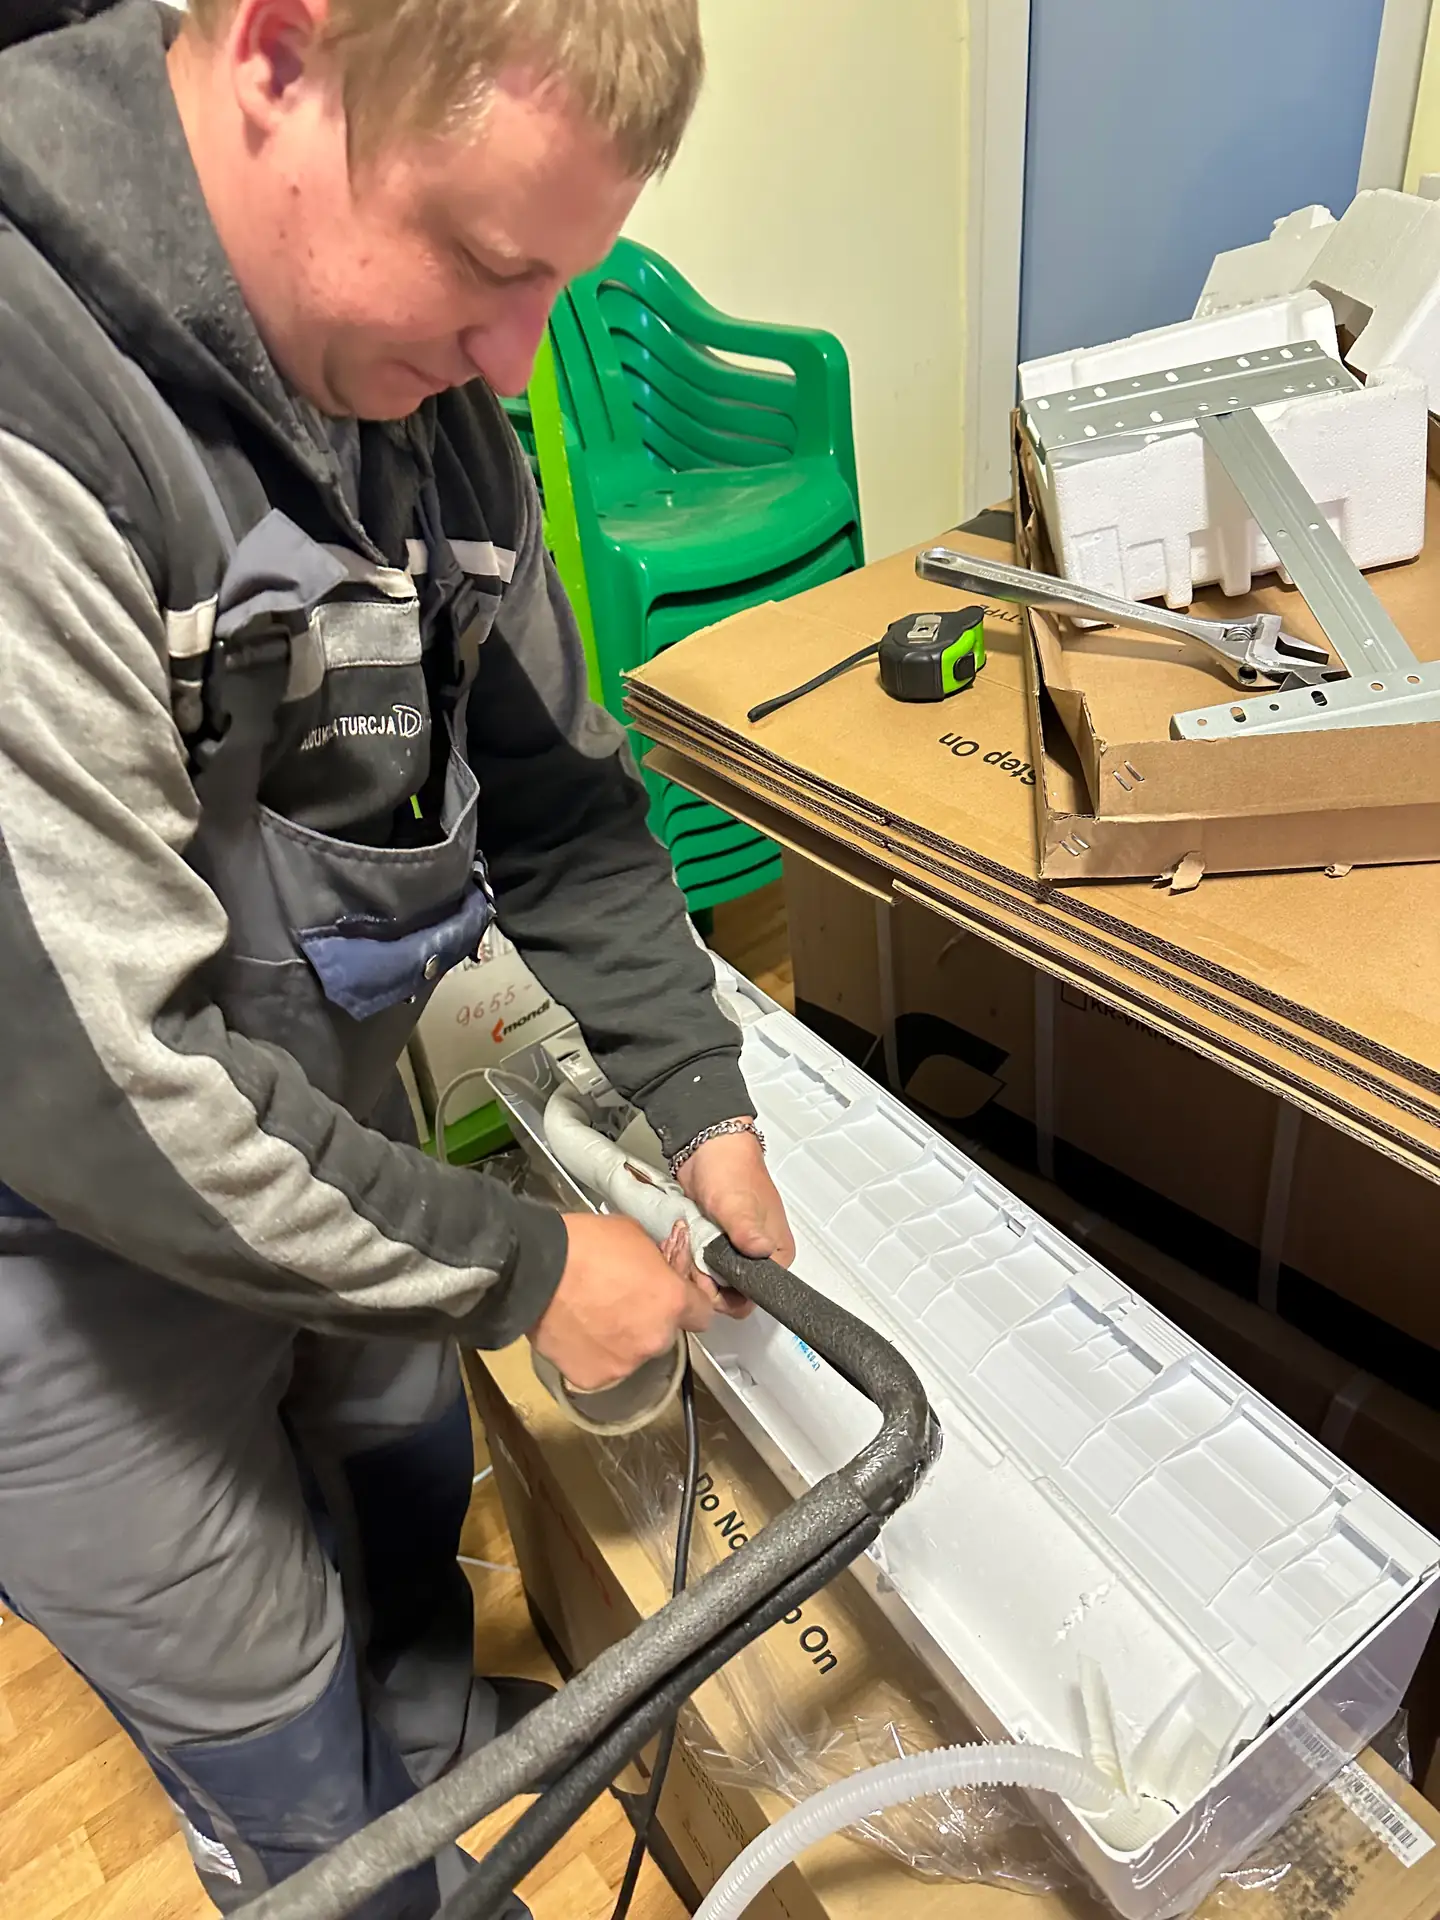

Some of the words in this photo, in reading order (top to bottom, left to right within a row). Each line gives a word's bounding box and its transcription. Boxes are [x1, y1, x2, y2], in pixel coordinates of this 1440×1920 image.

[339, 715, 397, 736] TURCJA
[938, 732, 980, 757] On
[503, 998, 551, 1037] mondi
[694, 1471, 720, 1512] Do
[713, 1510, 749, 1551] No
[799, 1624, 838, 1675] On
